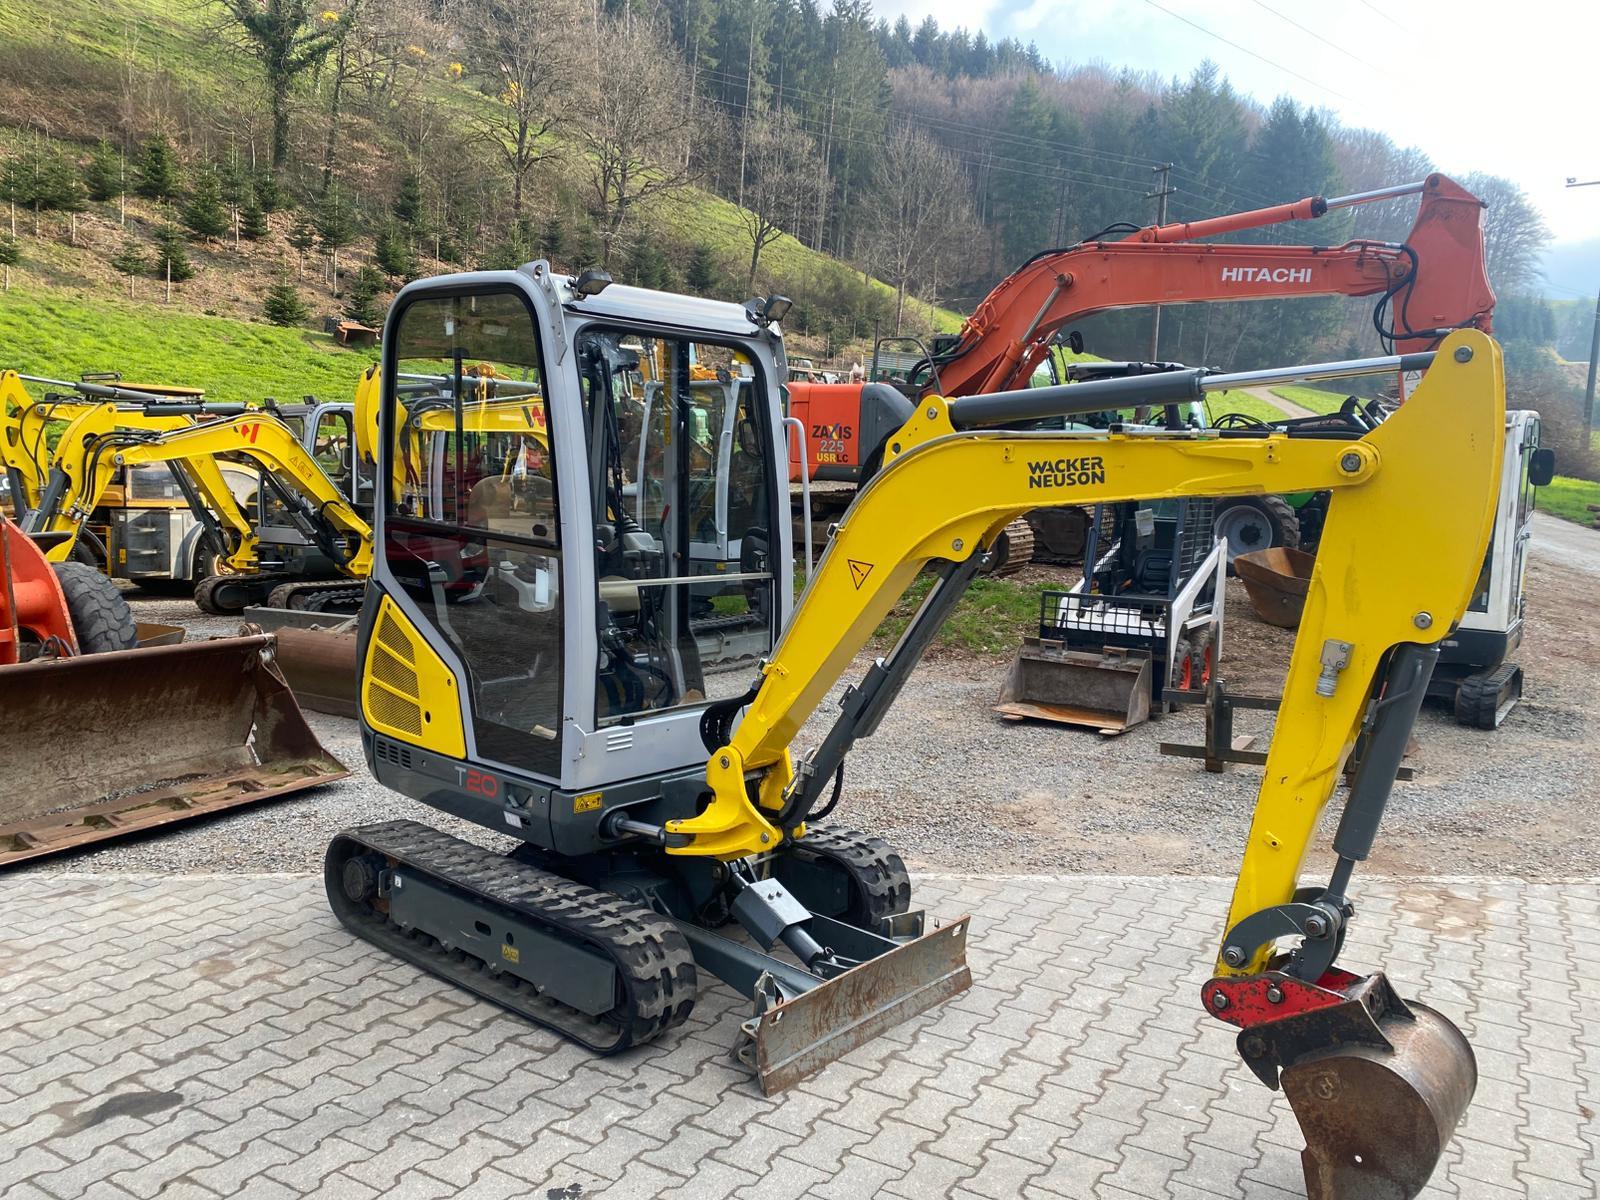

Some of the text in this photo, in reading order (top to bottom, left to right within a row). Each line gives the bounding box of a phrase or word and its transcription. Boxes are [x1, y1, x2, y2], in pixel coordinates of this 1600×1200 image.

[1221, 267, 1313, 283] HITACHI
[811, 422, 853, 440] ZAXIS
[820, 440, 845, 453] 225
[1027, 456, 1105, 475] WACKER
[1028, 470, 1105, 489] NEUSON
[454, 766, 498, 799] T20
